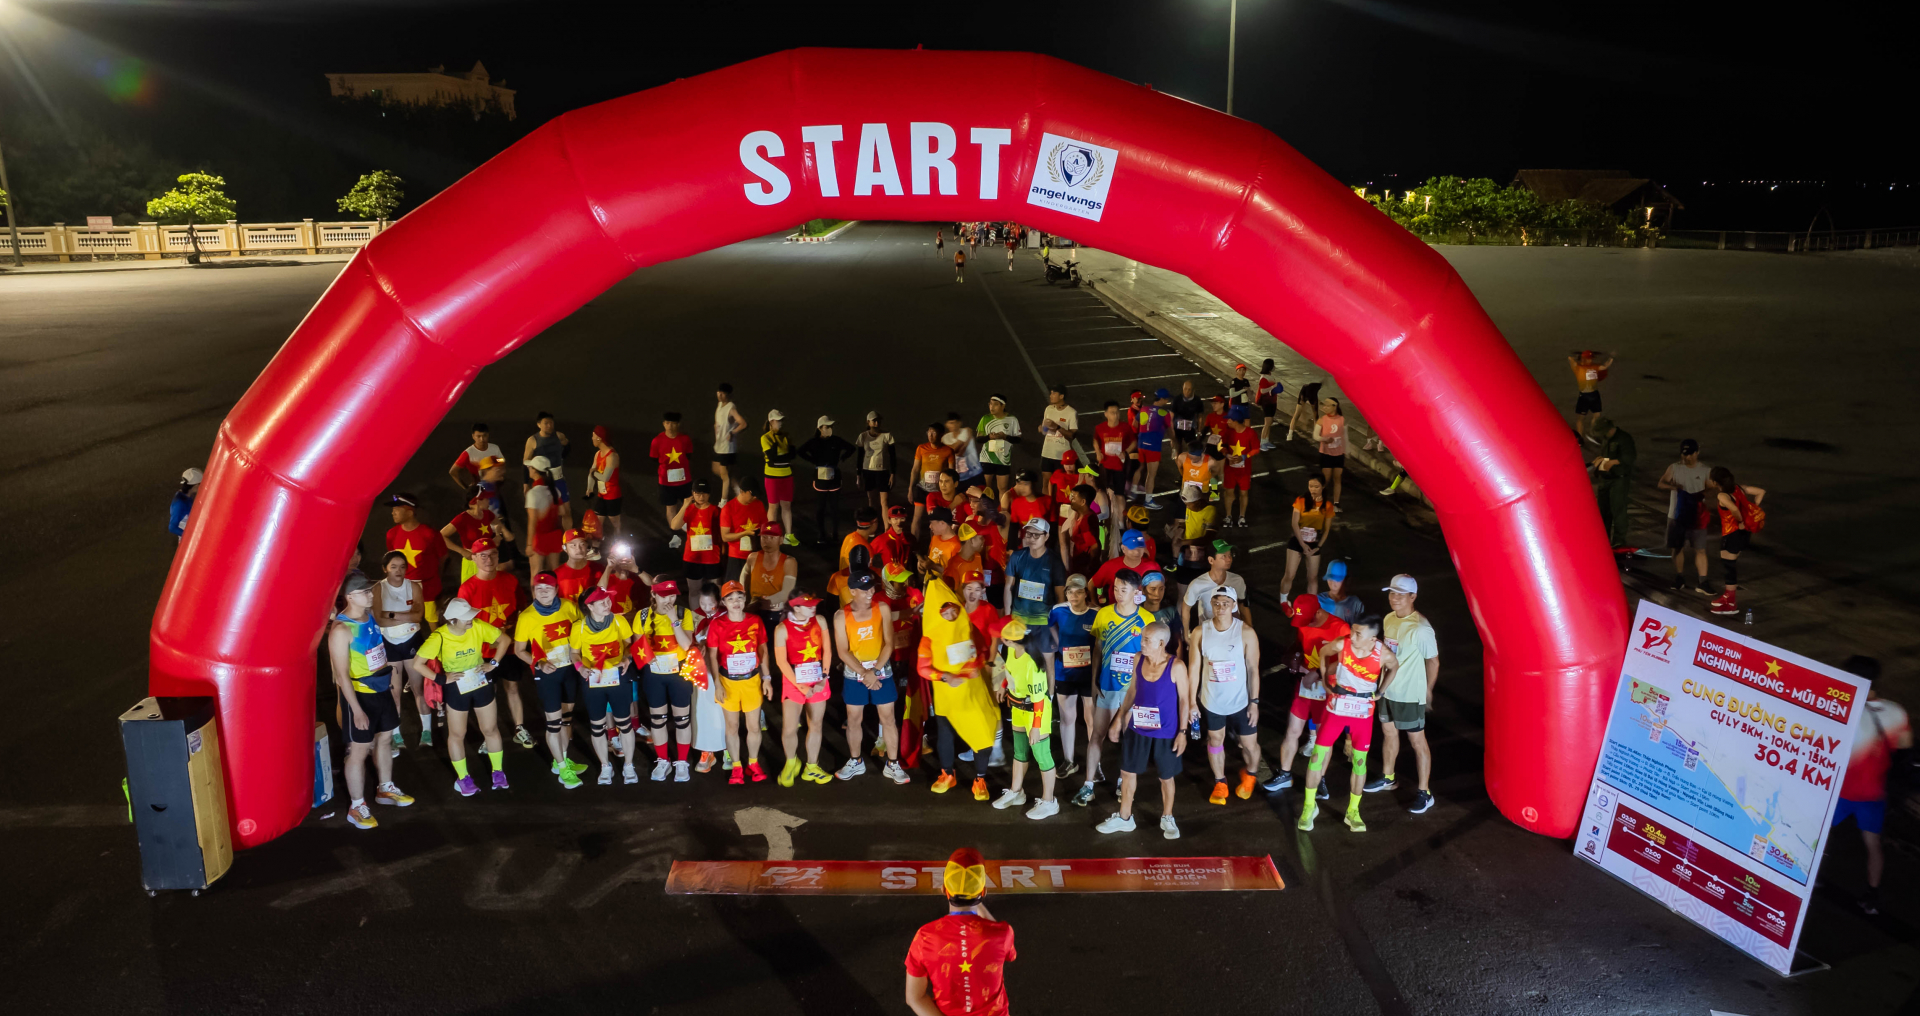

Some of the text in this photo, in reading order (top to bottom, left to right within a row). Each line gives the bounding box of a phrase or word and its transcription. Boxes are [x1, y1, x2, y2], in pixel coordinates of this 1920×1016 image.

[739, 121, 1012, 206] START
[1039, 199, 1090, 215] KINDERGARTEN
[1068, 652, 1084, 660] 517
[1700, 638, 1742, 661] LONG RUN
[732, 659, 751, 667] 527
[800, 668, 819, 676] 503
[1696, 650, 1741, 677] NGHINH
[1741, 667, 1785, 694] PHONG
[1791, 687, 1815, 705] MŨI
[1815, 696, 1847, 717] ĐIỆN
[1825, 685, 1851, 703] 2025
[1680, 676, 1840, 754] CUNG ĐƯỜNG CHẠY
[1709, 709, 1725, 724] CỰ
[1725, 715, 1740, 730] LY
[1740, 722, 1763, 740] 5KM
[1769, 734, 1800, 755] 10KM
[1753, 742, 1833, 791] 30.4 KM
[881, 865, 1071, 891] STRT
[1175, 867, 1226, 875] PHONG
[1766, 912, 1786, 927] 09:00
